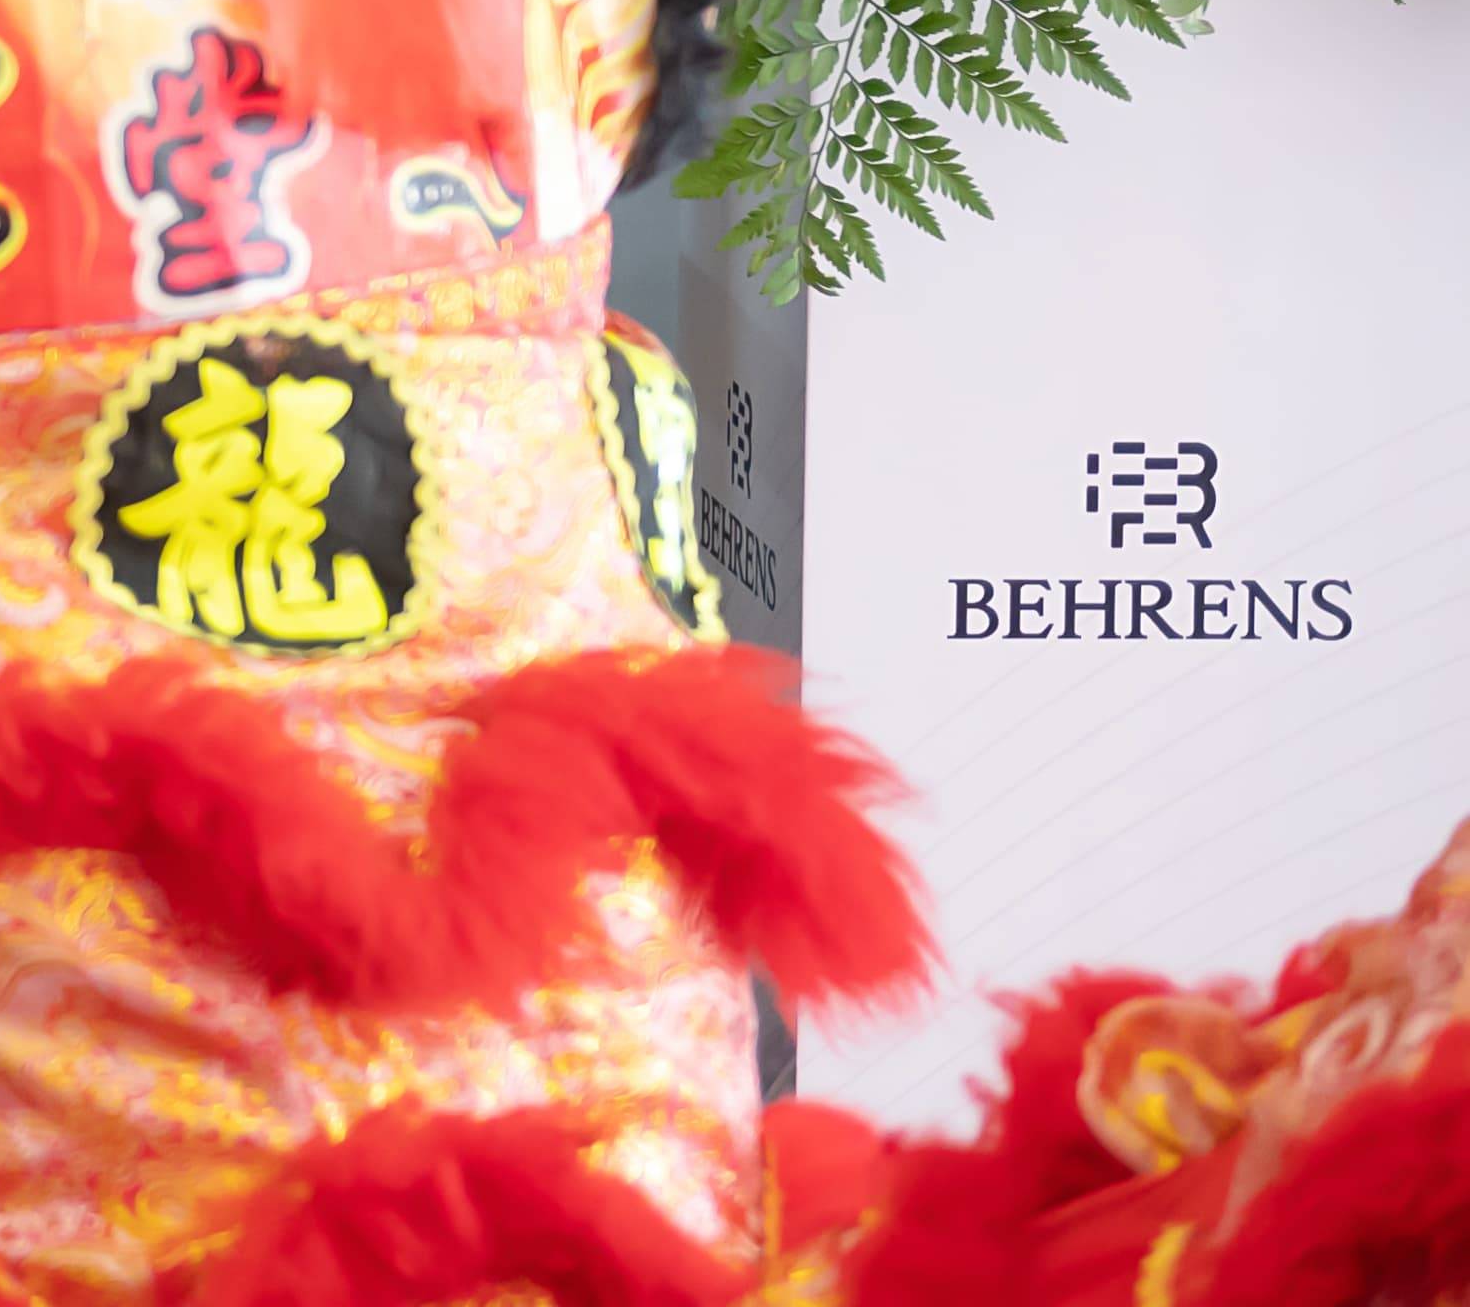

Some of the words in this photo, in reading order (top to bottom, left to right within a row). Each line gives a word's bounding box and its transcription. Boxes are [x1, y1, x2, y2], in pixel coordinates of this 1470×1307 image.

[118, 357, 389, 641] 龍
[699, 487, 777, 612] BEHRENS
[946, 578, 1354, 641] BEHRENS
